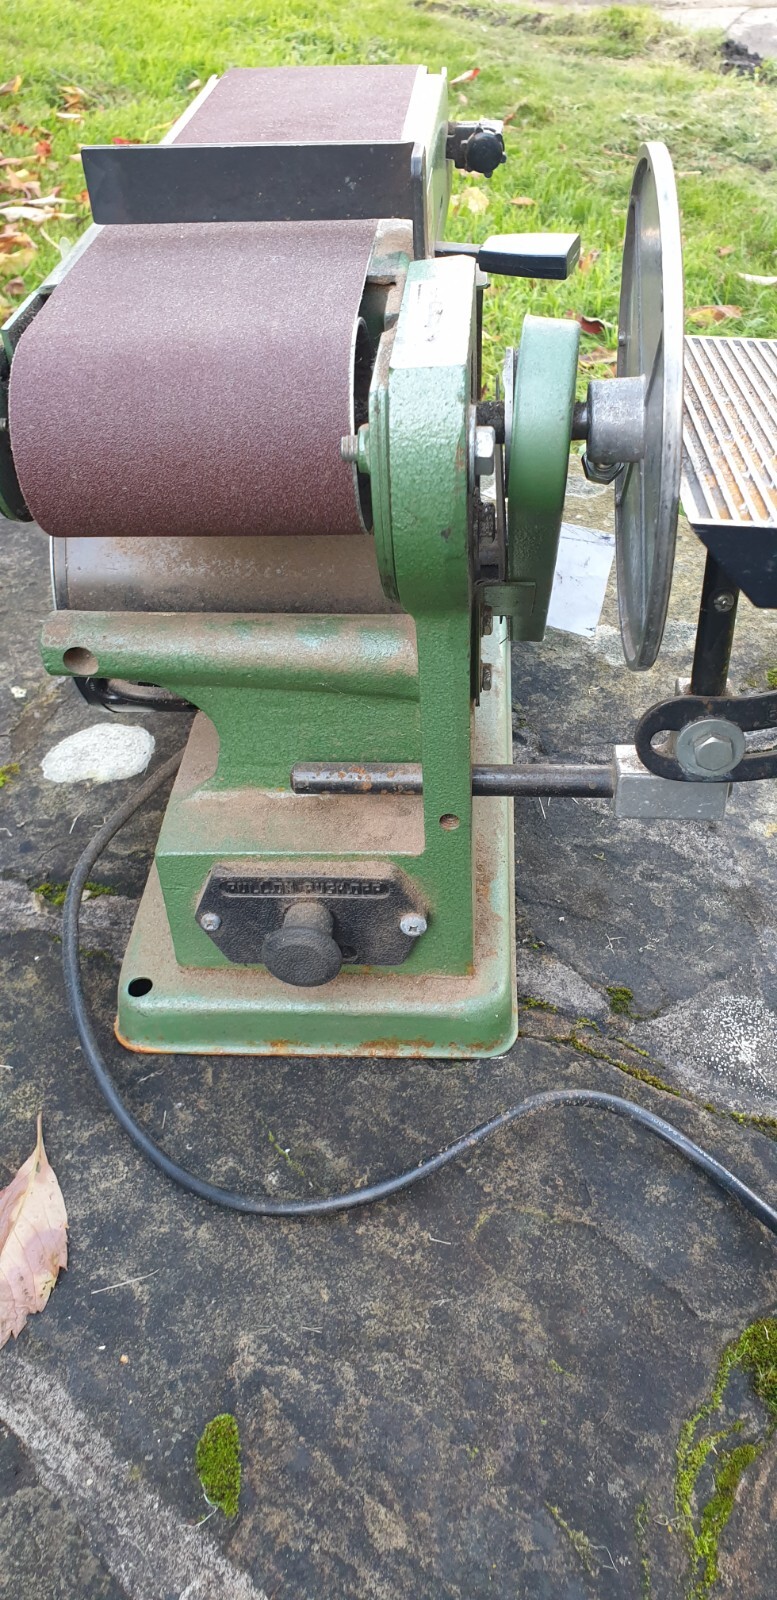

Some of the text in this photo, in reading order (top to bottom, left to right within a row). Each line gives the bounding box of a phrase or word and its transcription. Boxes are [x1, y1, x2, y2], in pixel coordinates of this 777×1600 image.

[226, 882, 270, 894] PULL
[304, 882, 344, 895] PUSH
[691, 1143, 719, 1166] KWANG
